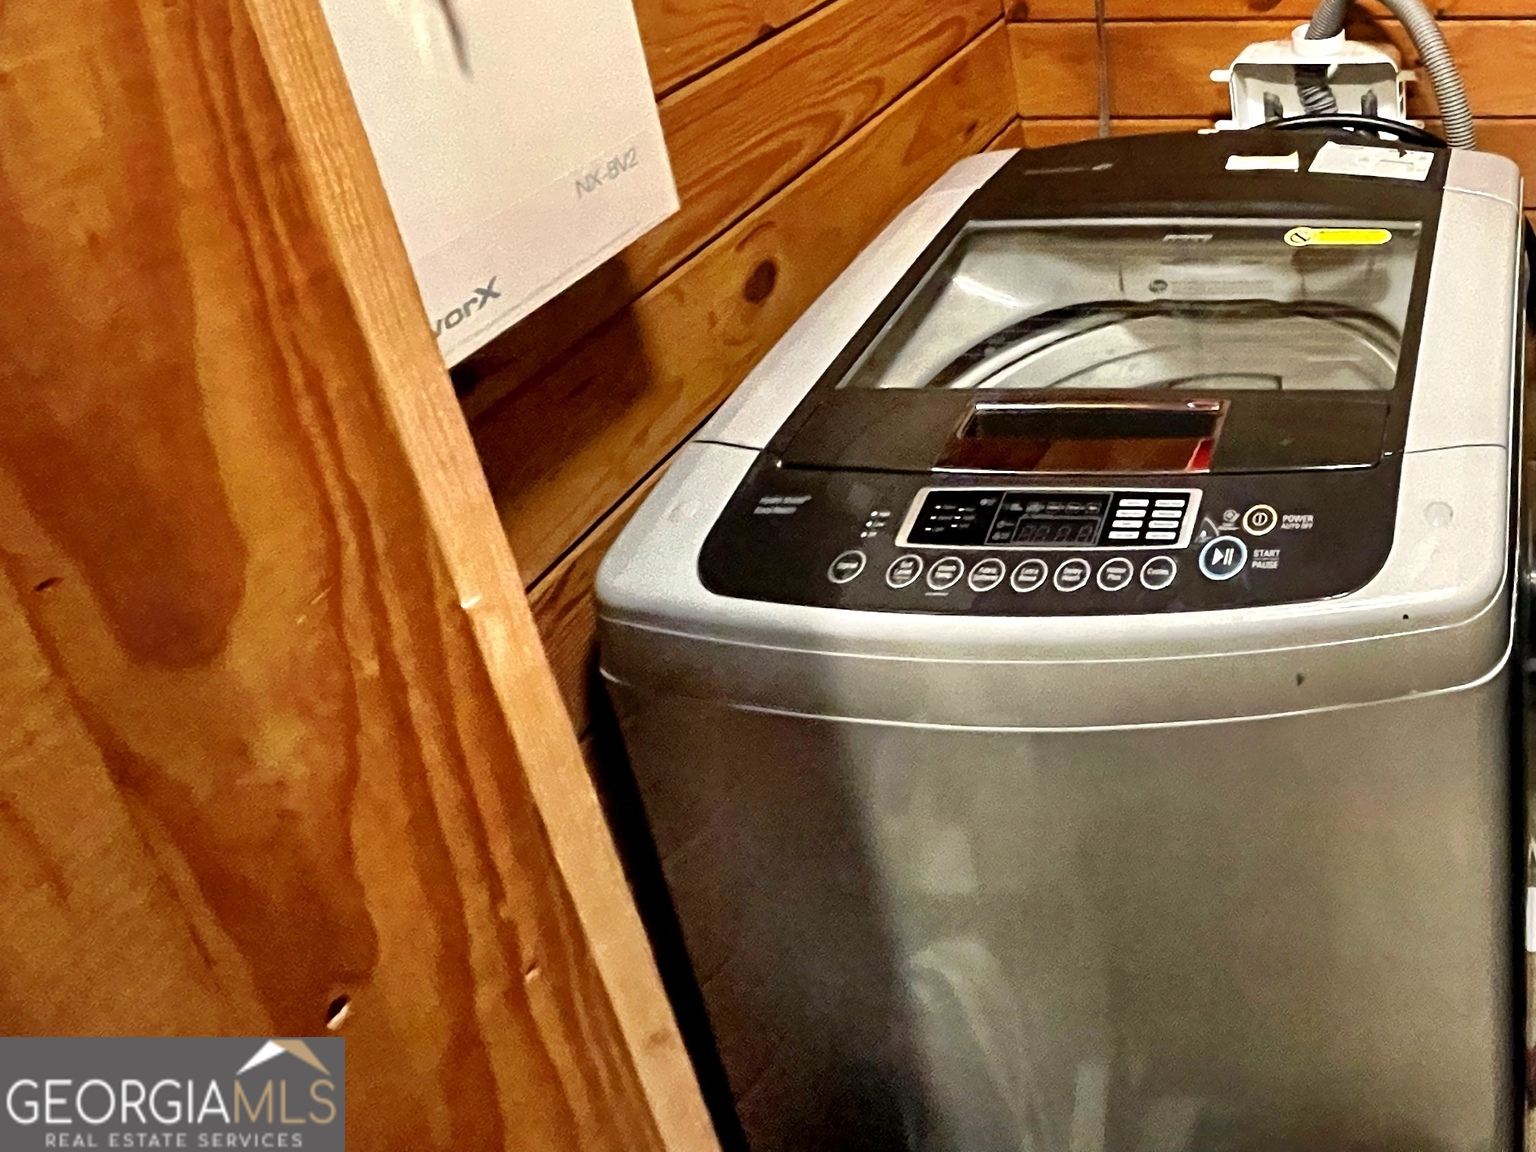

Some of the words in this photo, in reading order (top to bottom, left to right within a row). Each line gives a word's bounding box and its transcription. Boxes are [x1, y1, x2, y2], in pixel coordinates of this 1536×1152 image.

[1282, 514, 1314, 523] POWER
[1253, 549, 1280, 557] START
[1251, 560, 1279, 569] PAUSE
